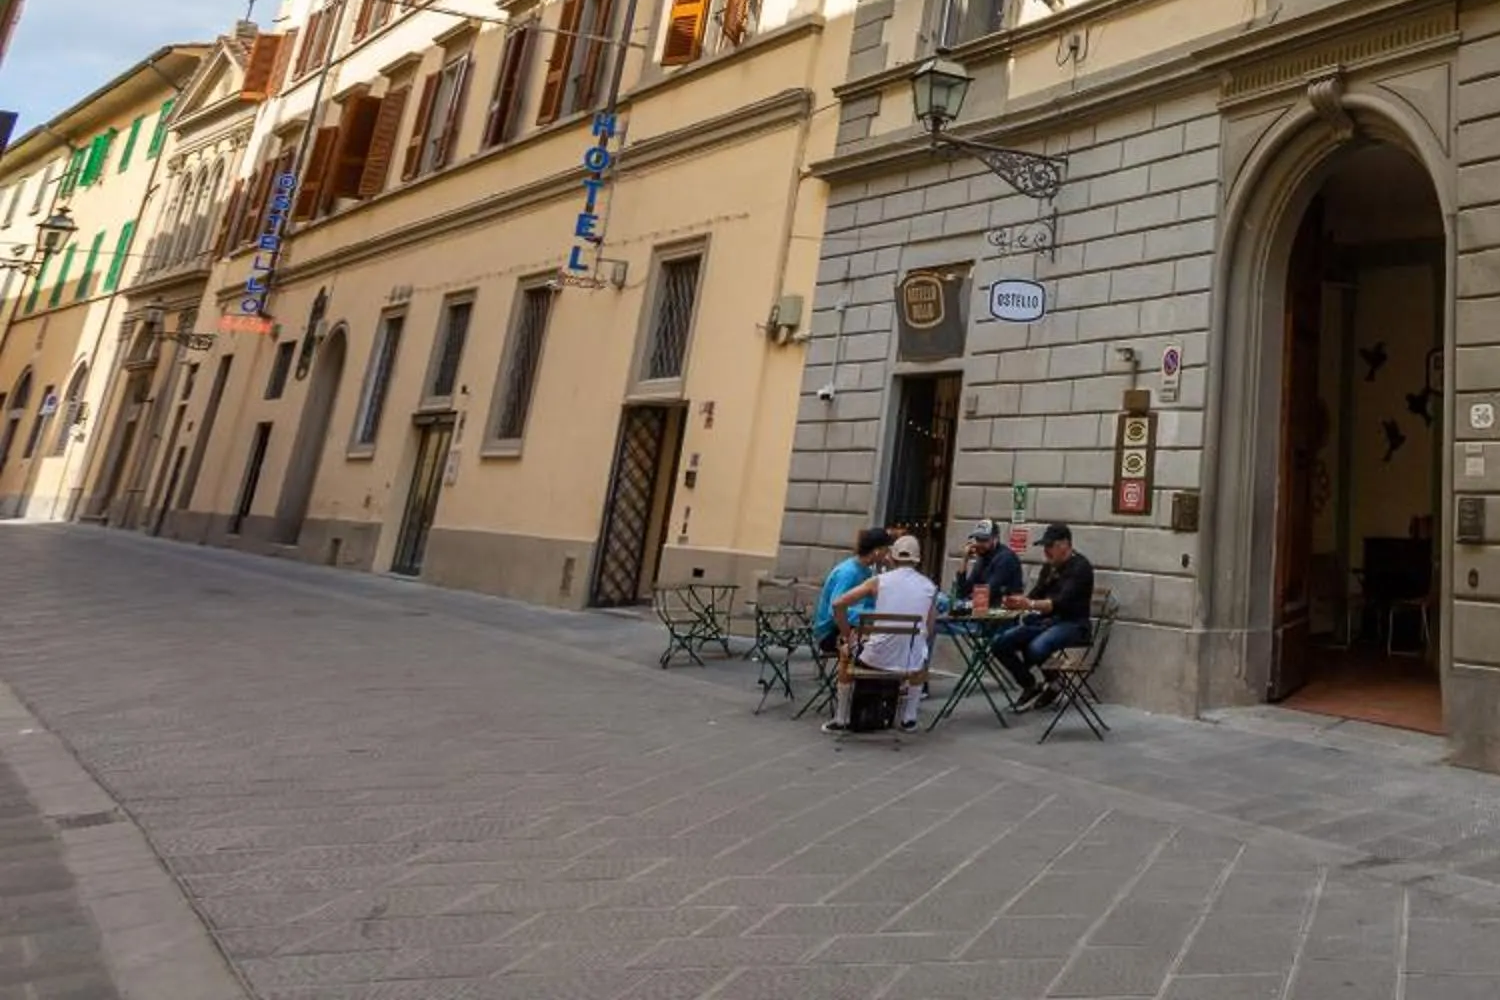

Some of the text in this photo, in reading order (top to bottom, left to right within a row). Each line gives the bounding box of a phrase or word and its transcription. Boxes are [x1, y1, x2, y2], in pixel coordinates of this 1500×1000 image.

[240, 173, 296, 313] OSTELLO
[567, 112, 617, 271] HOTEL
[997, 292, 1039, 309] OSTELLO
